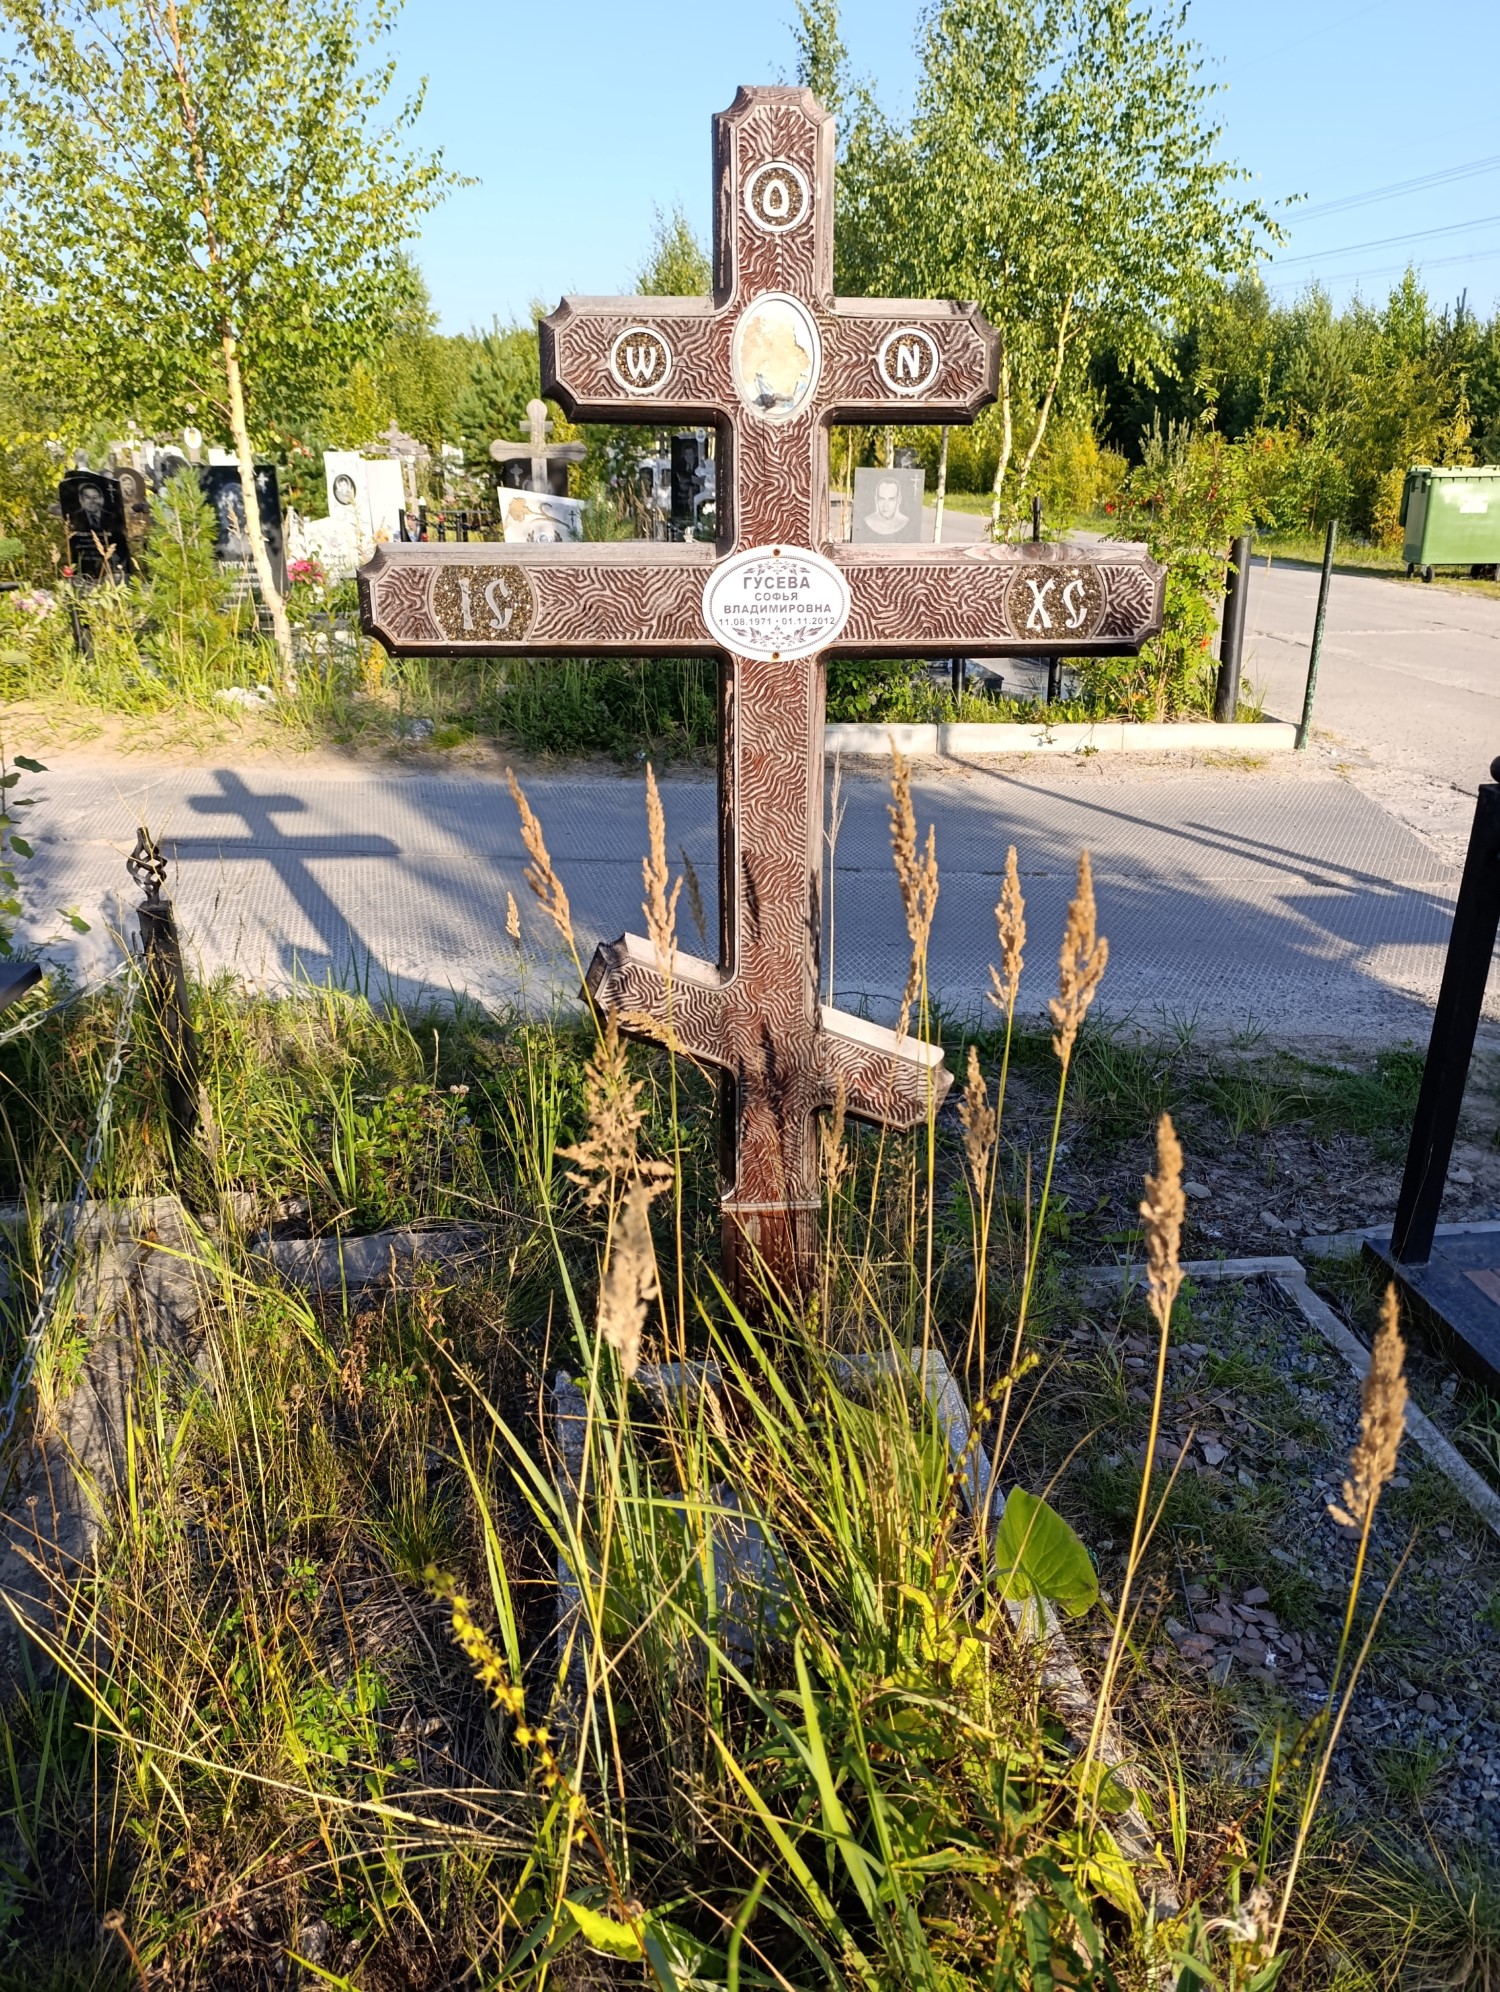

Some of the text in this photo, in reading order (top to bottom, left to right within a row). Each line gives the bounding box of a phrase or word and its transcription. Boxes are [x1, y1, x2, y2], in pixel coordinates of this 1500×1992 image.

[743, 576, 811, 590] ГУСЕВА
[754, 592, 798, 602] СОФЬЯ
[723, 604, 832, 615] ВЛАДИМИРОВНА
[718, 616, 836, 626] 11.08.1971 01.11.2012
